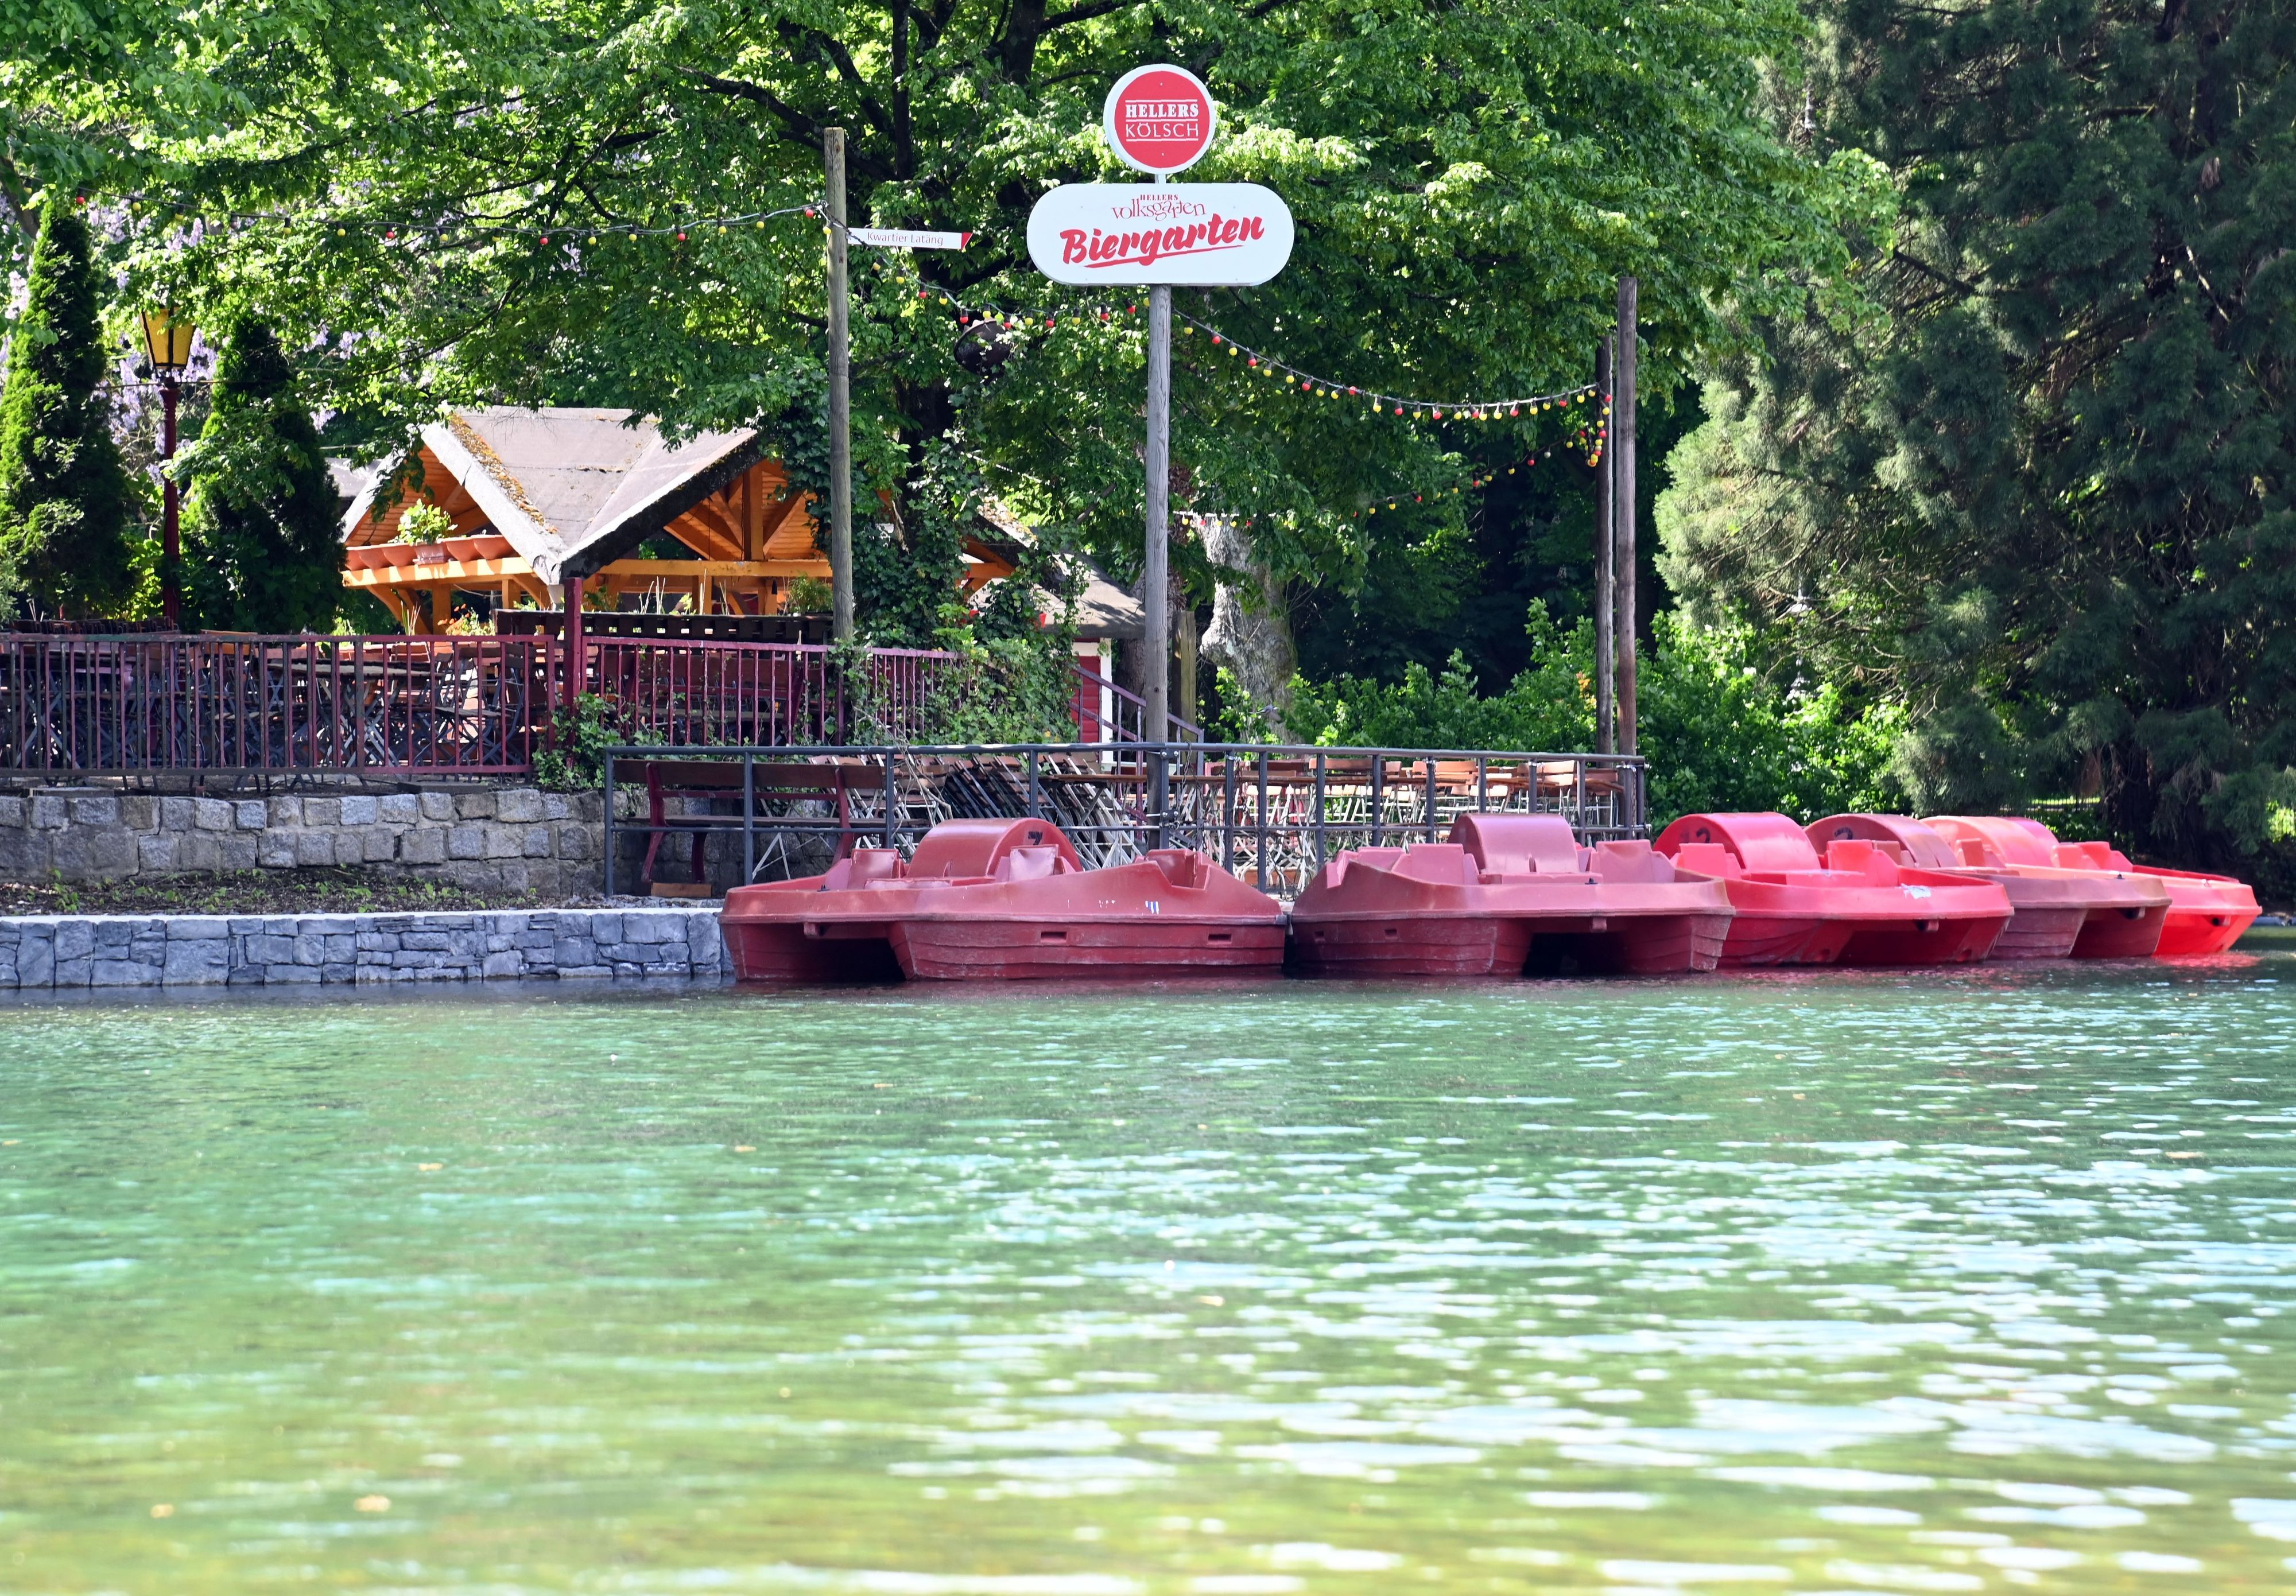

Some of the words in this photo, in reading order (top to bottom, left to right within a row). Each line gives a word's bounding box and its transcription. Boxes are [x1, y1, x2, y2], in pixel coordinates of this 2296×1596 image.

[1126, 103, 1199, 118] HELLERS
[1126, 122, 1199, 138] KÖLSCH
[1111, 198, 1207, 222] volksgarten
[867, 231, 908, 243] Kwartier
[911, 234, 944, 246] Latäng
[1060, 213, 1265, 266] Biergarten
